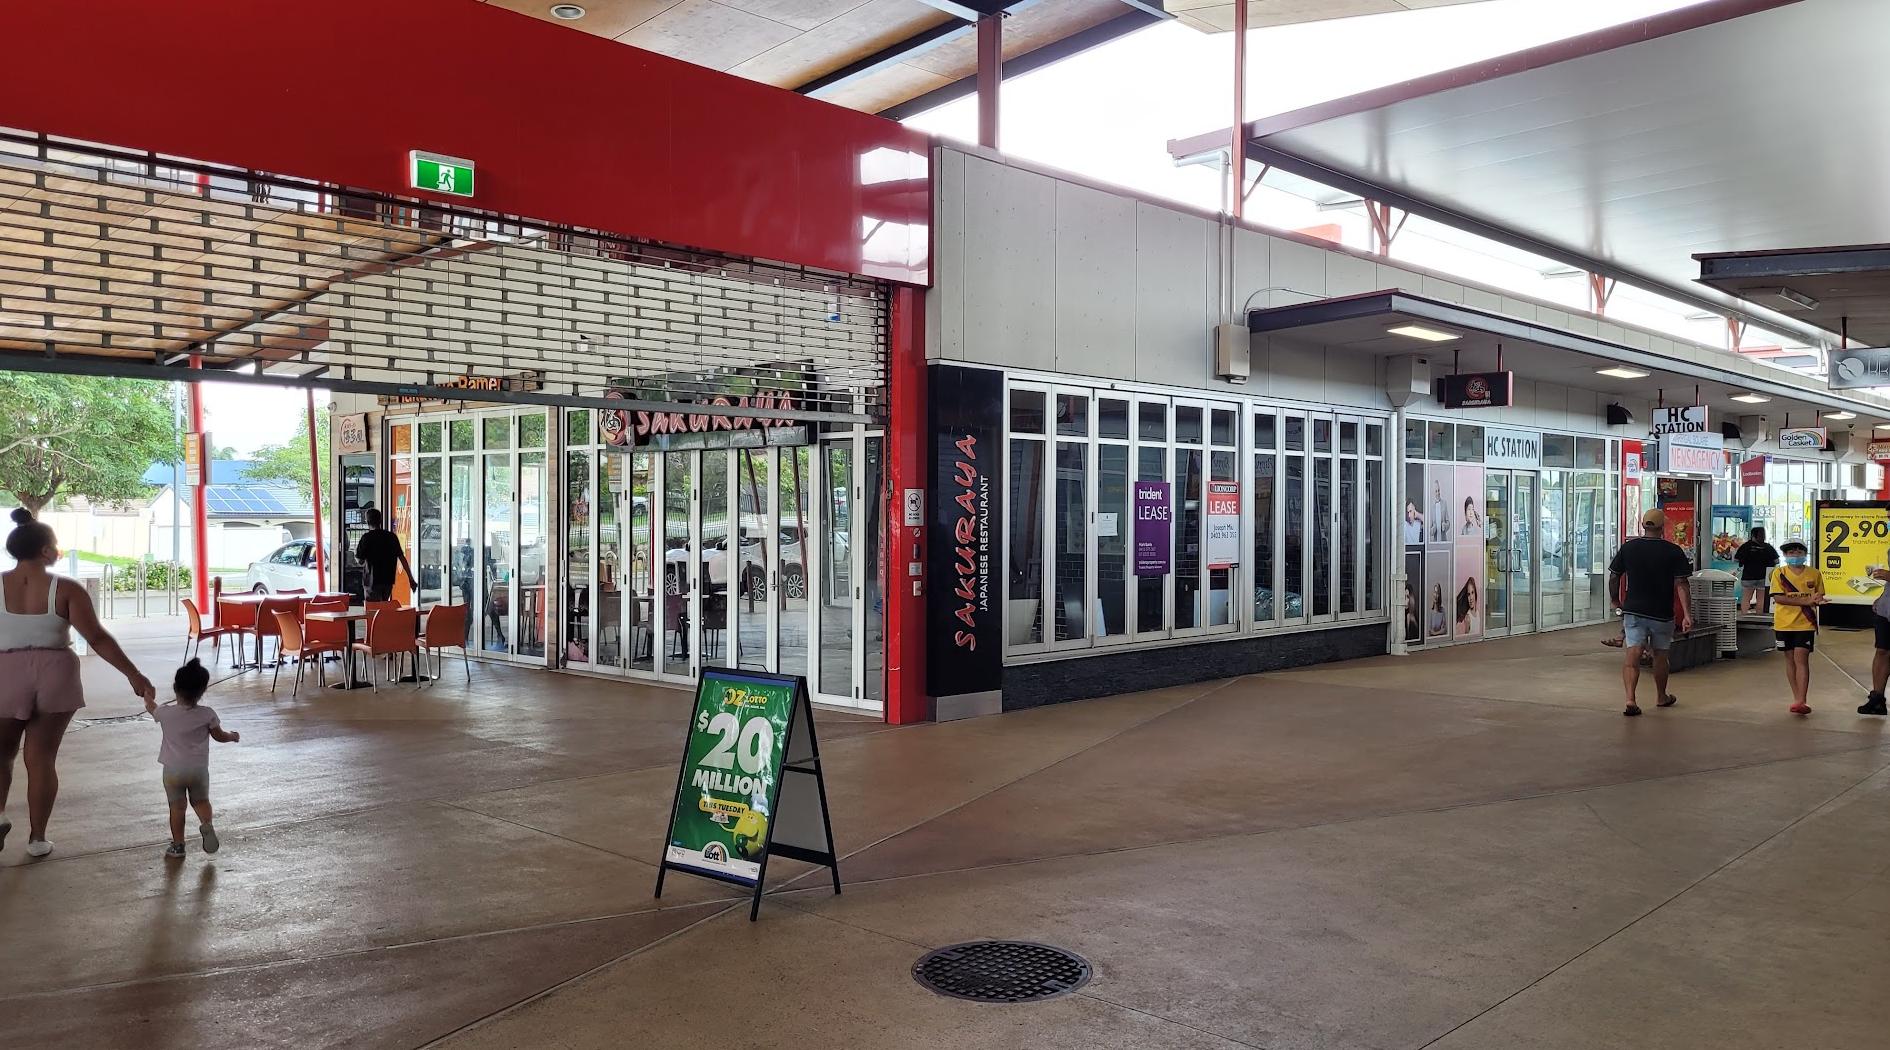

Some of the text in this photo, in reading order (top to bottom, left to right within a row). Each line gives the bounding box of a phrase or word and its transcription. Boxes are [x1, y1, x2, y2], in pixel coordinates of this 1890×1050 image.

[1668, 407, 1690, 422] HC
[1655, 421, 1704, 433] STATION
[1781, 434, 1807, 442] Golden
[1788, 439, 1812, 447] Casket
[1487, 436, 1538, 459] HC STATION
[1138, 486, 1163, 500] trident
[1138, 506, 1168, 521] LEASE
[1209, 501, 1237, 514] LEASE
[955, 434, 976, 652] SAKURAYA
[979, 474, 989, 612] JAPANESE RESTAURANT
[697, 709, 774, 775] $20
[691, 769, 768, 798] MILLION
[703, 800, 746, 814] THIS TUESDAY
